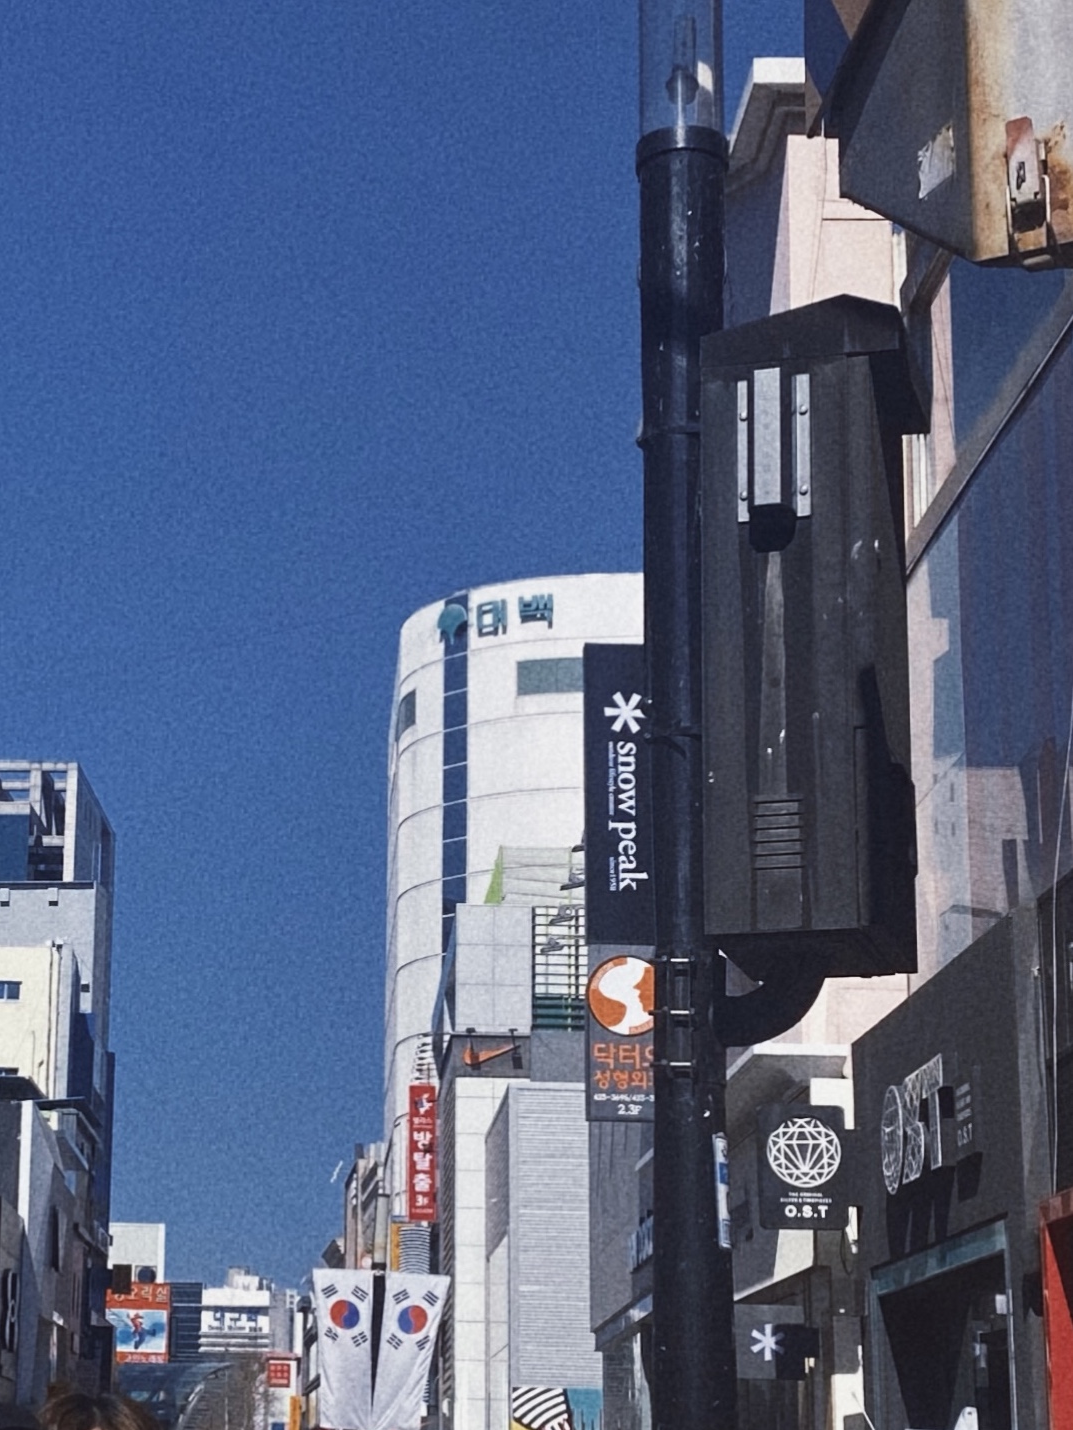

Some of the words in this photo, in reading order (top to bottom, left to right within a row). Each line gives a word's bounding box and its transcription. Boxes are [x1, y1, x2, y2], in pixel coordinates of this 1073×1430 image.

[476, 593, 554, 637] 대백
[616, 741, 637, 816] snow
[608, 819, 649, 891] peak
[593, 1069, 654, 1090] 성형외
[785, 1204, 828, 1218] O.S.T
